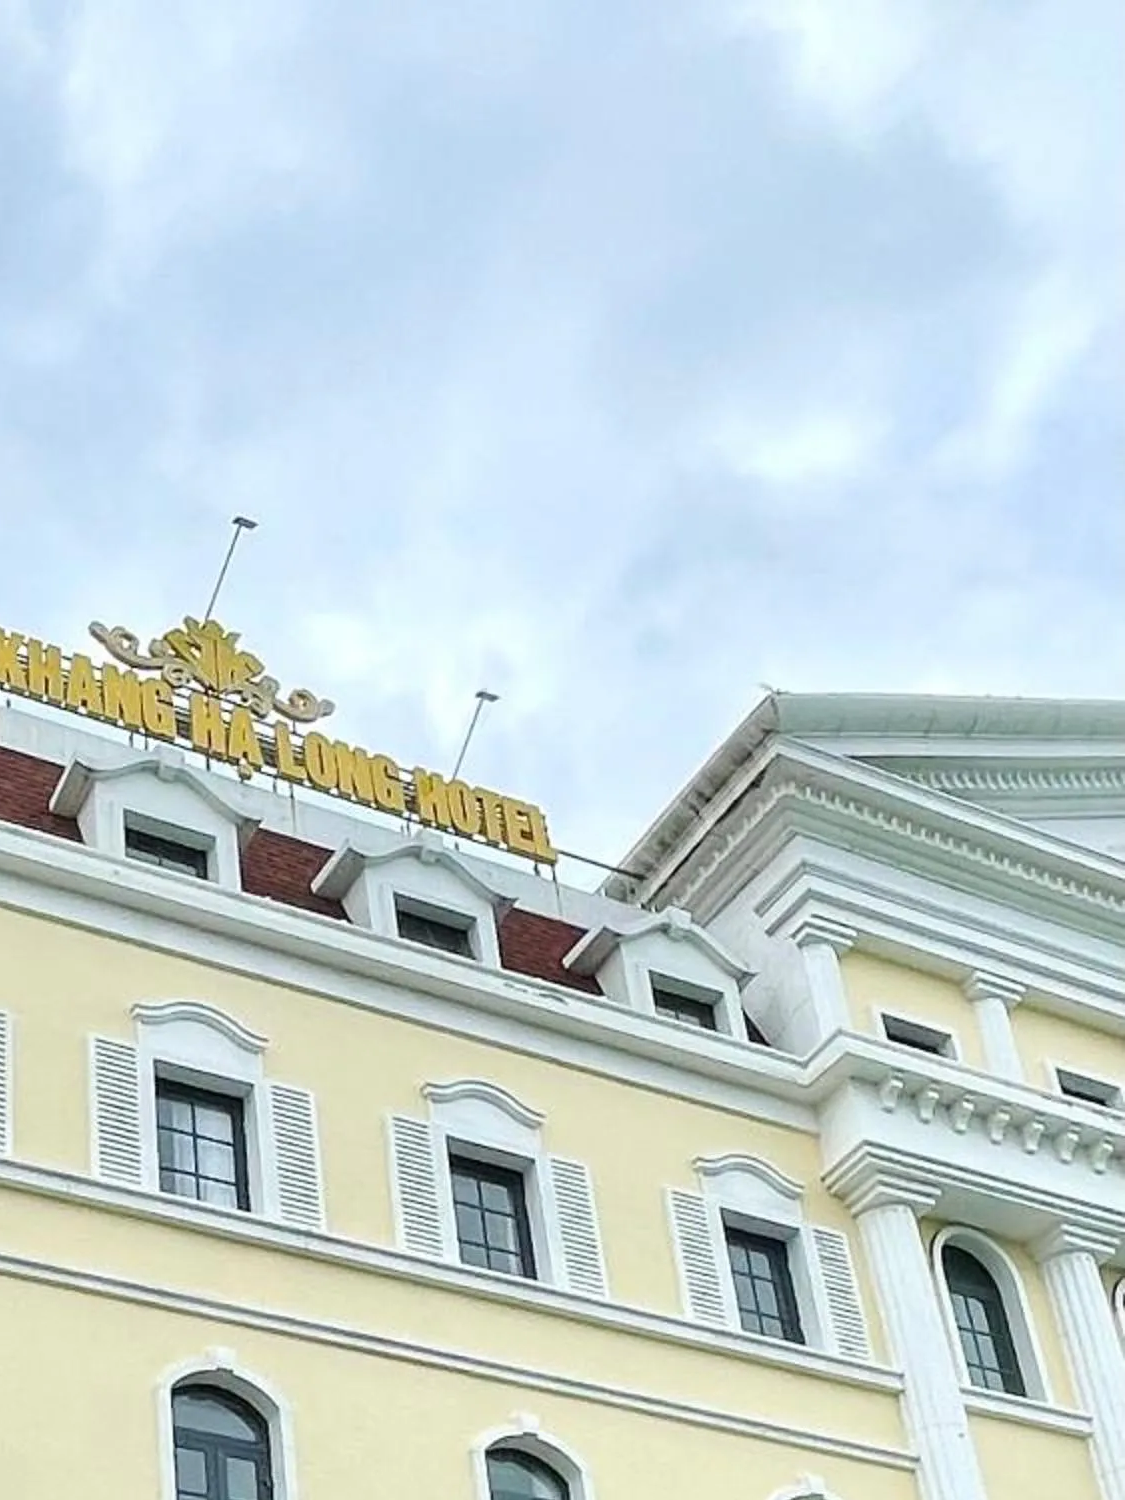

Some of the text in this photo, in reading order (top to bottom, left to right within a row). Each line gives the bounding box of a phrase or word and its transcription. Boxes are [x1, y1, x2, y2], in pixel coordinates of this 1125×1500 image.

[189, 692, 264, 781] HẠ
[276, 720, 406, 816] LONG
[414, 767, 557, 864] HOTEL
